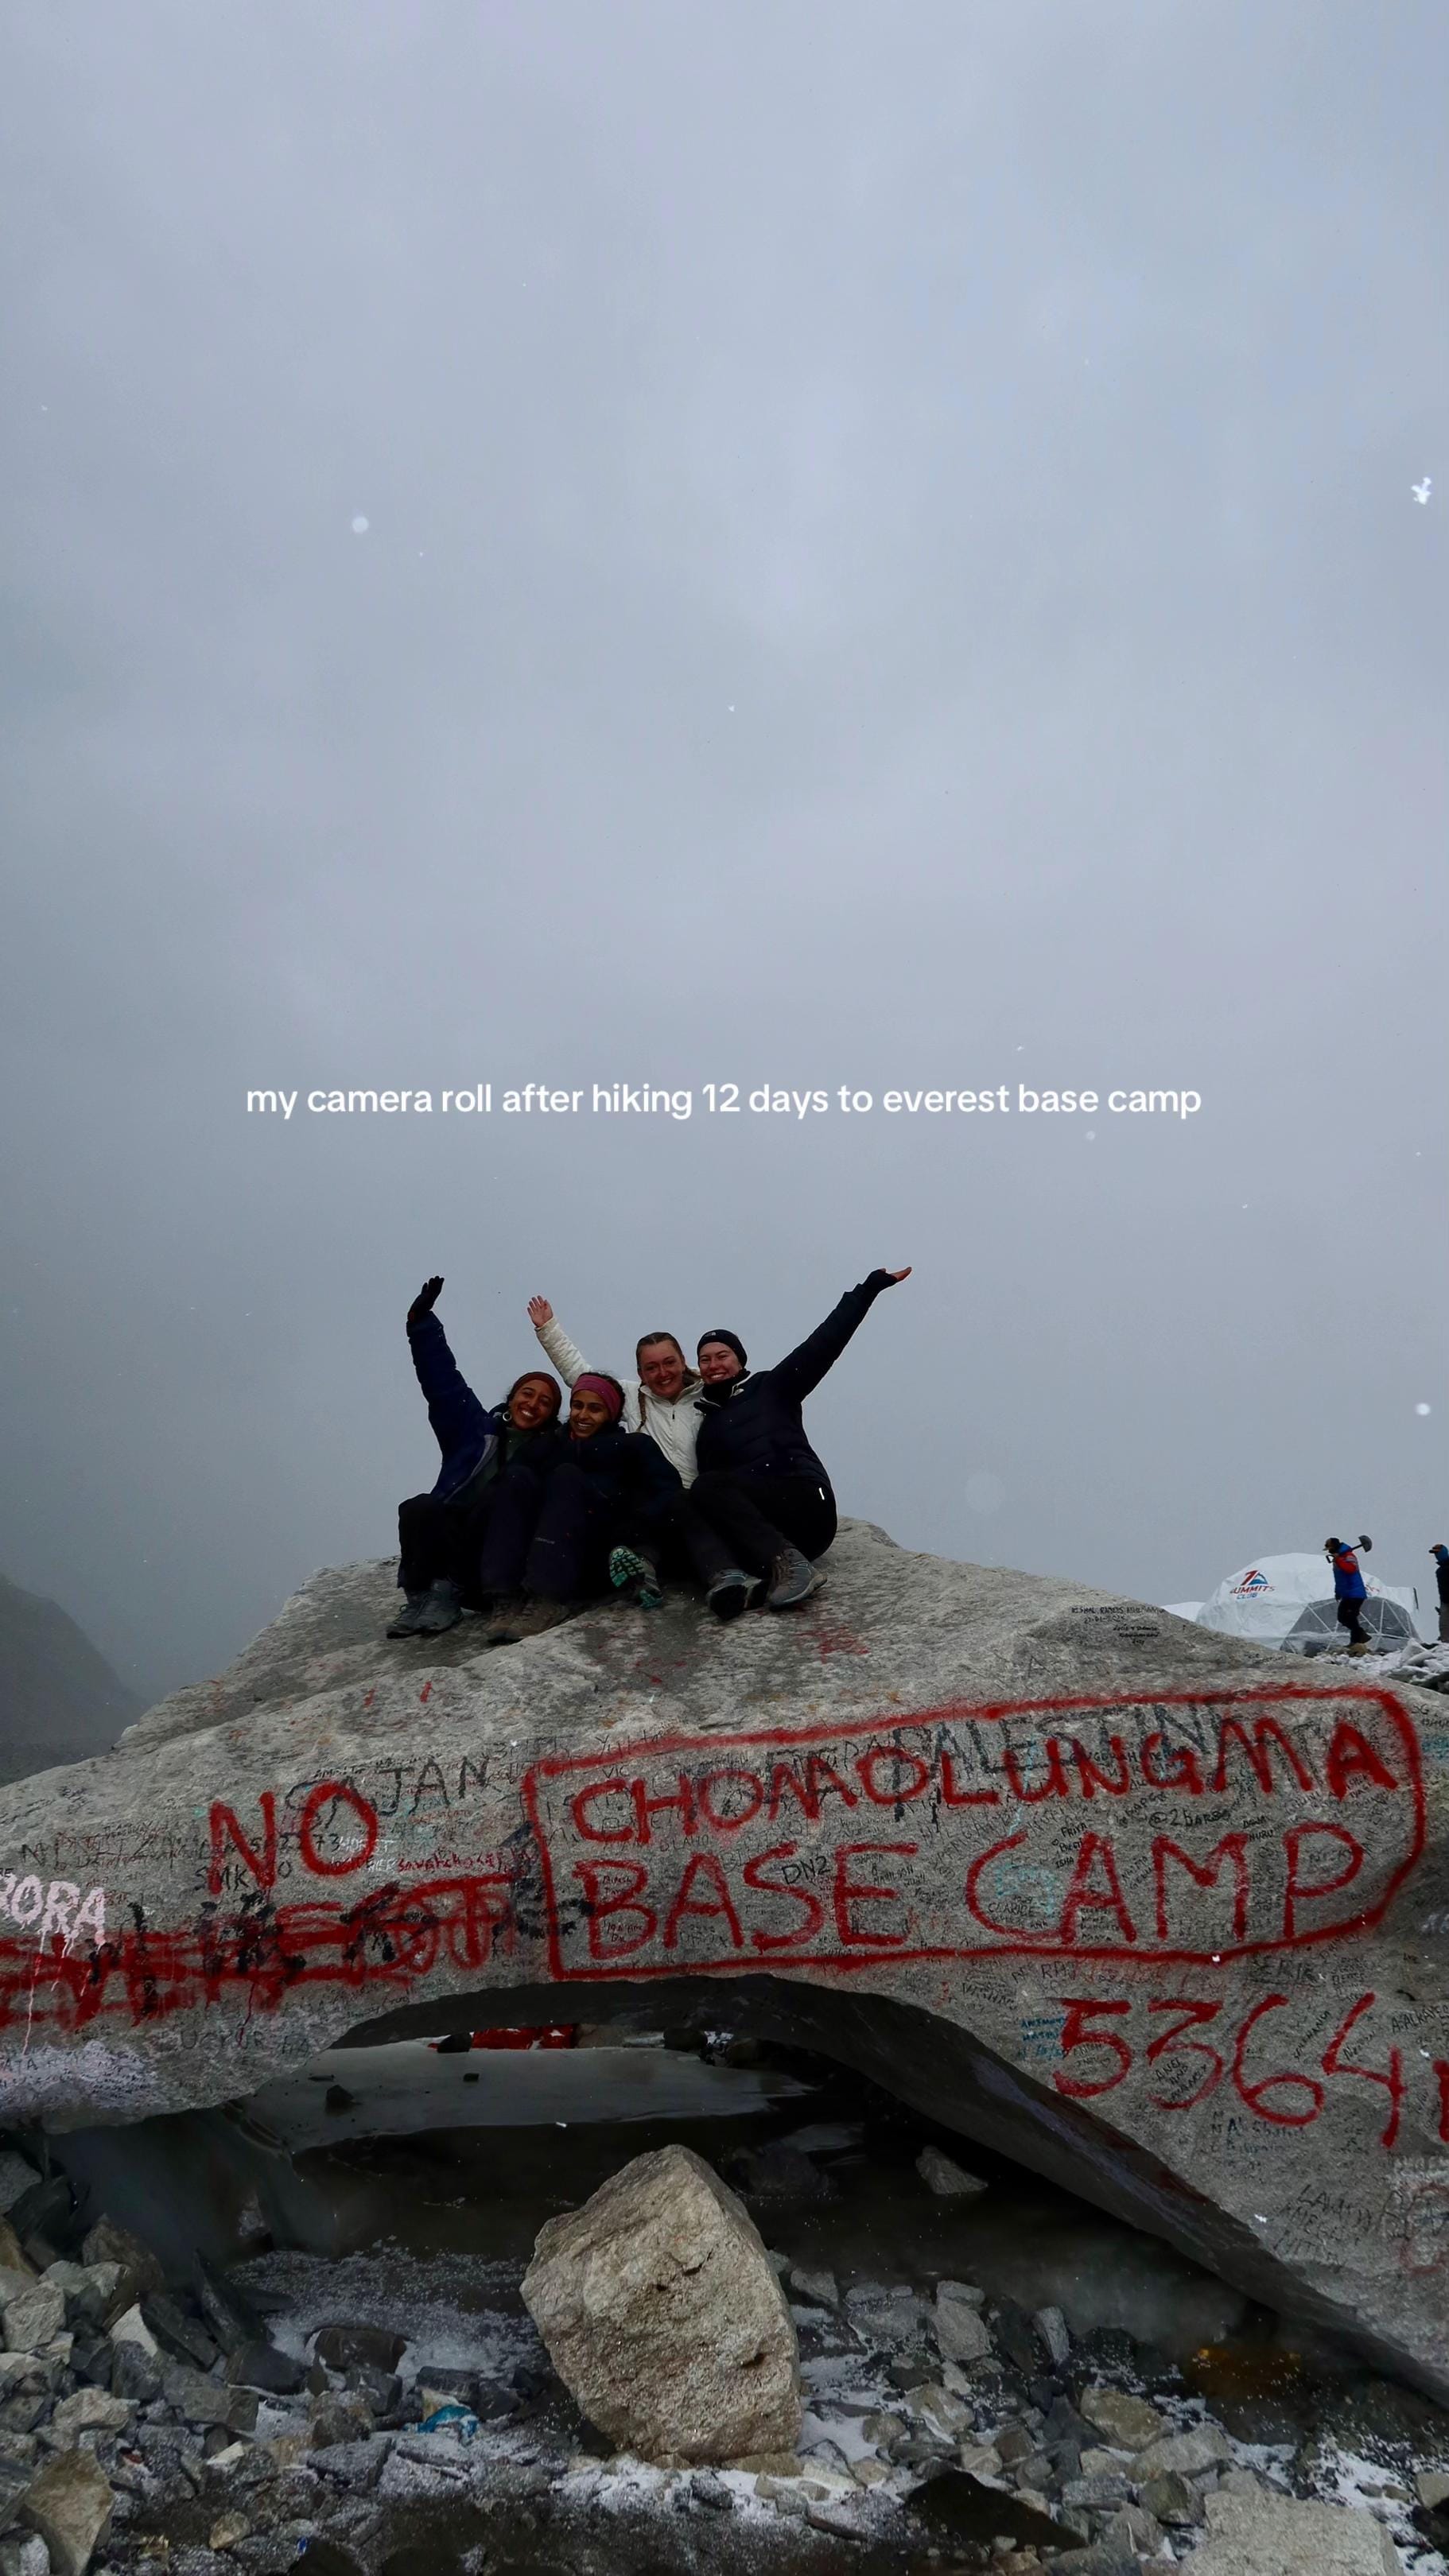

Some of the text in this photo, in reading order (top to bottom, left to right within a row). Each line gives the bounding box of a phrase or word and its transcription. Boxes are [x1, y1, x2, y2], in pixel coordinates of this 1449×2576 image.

[208, 1779, 379, 1896] NO
[572, 1717, 1399, 1845] CHOMOLUNGMA
[573, 1841, 918, 1960] BASE
[965, 1821, 1365, 1946] CAMP
[782, 1852, 832, 1885] DN2
